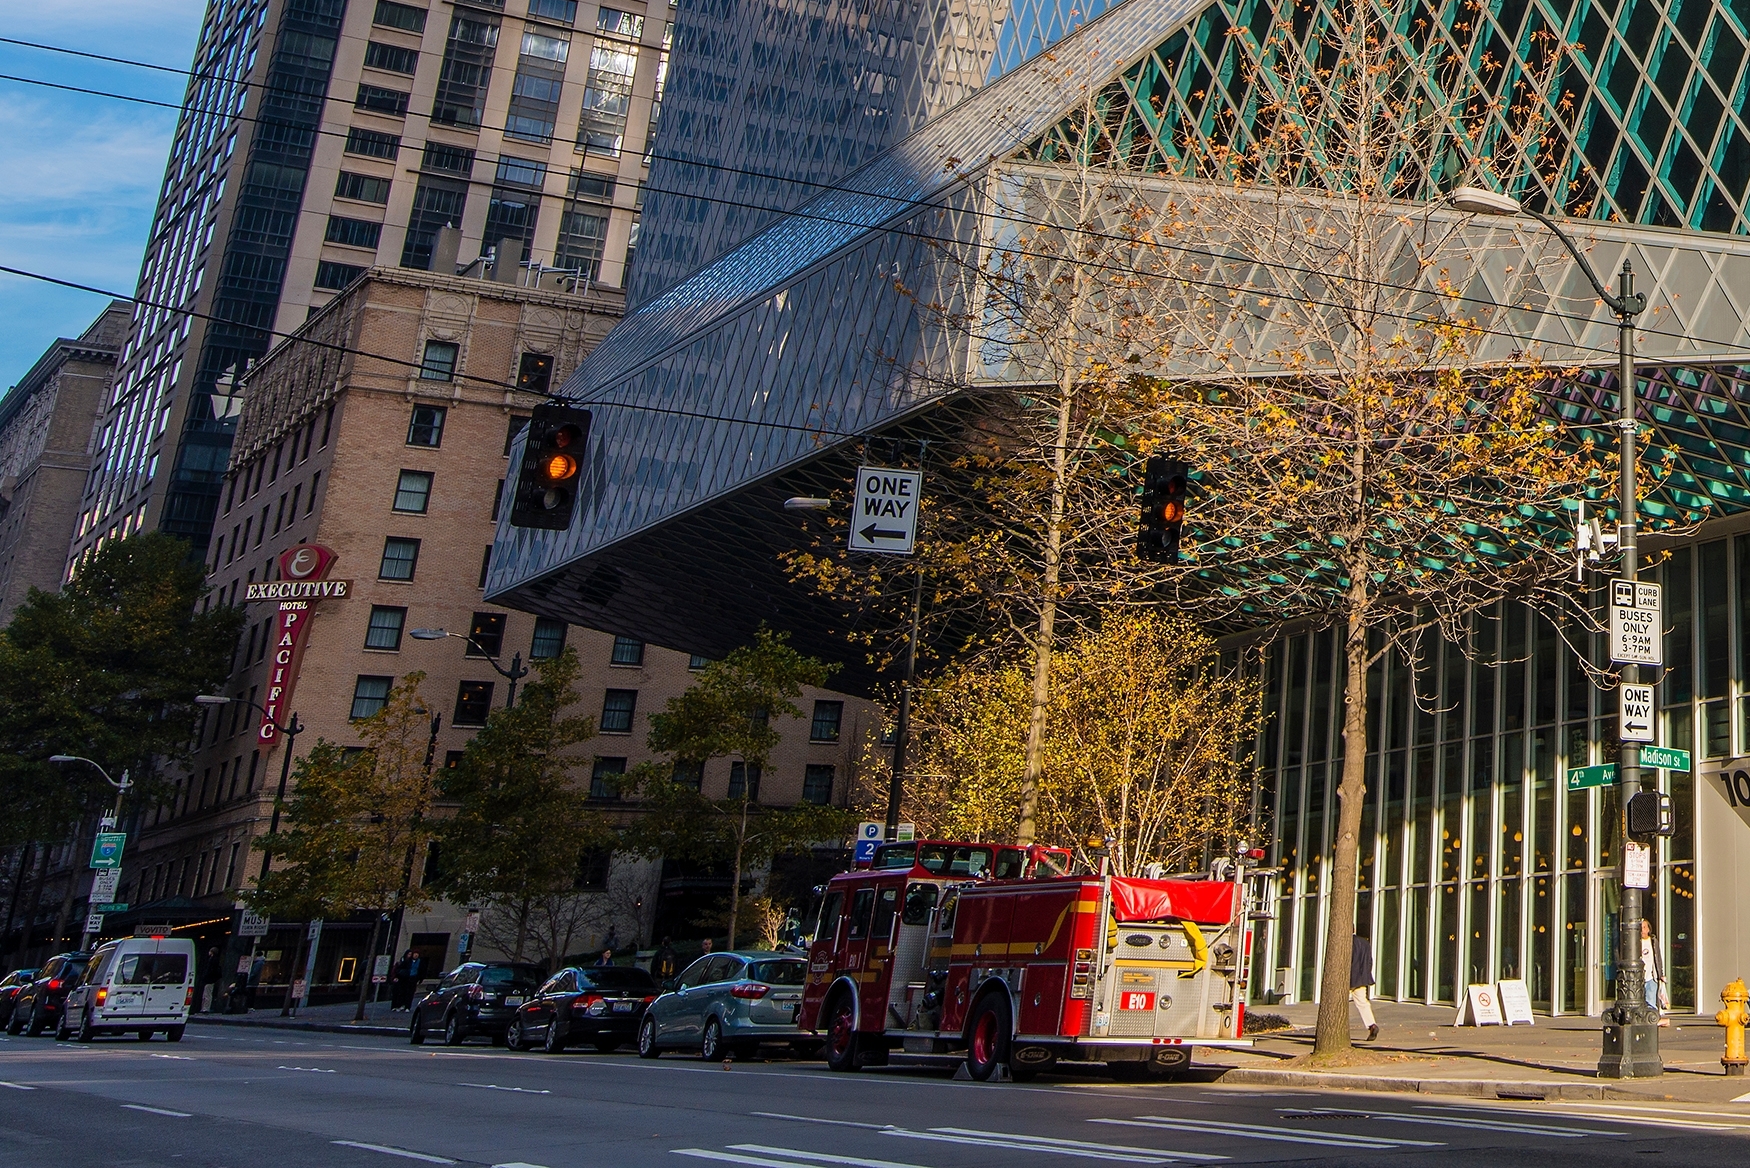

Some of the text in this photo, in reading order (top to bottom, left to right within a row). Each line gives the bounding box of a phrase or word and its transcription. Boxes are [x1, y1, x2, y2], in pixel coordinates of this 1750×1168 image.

[866, 475, 912, 497] ONE
[864, 497, 911, 519] WAY
[245, 581, 347, 600] EXECUTIVE
[1638, 587, 1657, 597] CURB
[279, 601, 308, 611] HOTEL
[1638, 597, 1657, 607] LANE
[1620, 609, 1653, 623] BUSES
[1623, 622, 1649, 634] ONLY
[1622, 634, 1651, 645] 6-9AM
[1622, 644, 1651, 654] 3-7PM
[260, 613, 297, 739] PACIFIC
[1625, 688, 1649, 702] ONE
[1624, 704, 1650, 718] WAY
[1641, 748, 1672, 767] Madison
[865, 843, 875, 855] 2
[1629, 852, 1646, 860] STOPS
[1128, 993, 1146, 1010] E10
